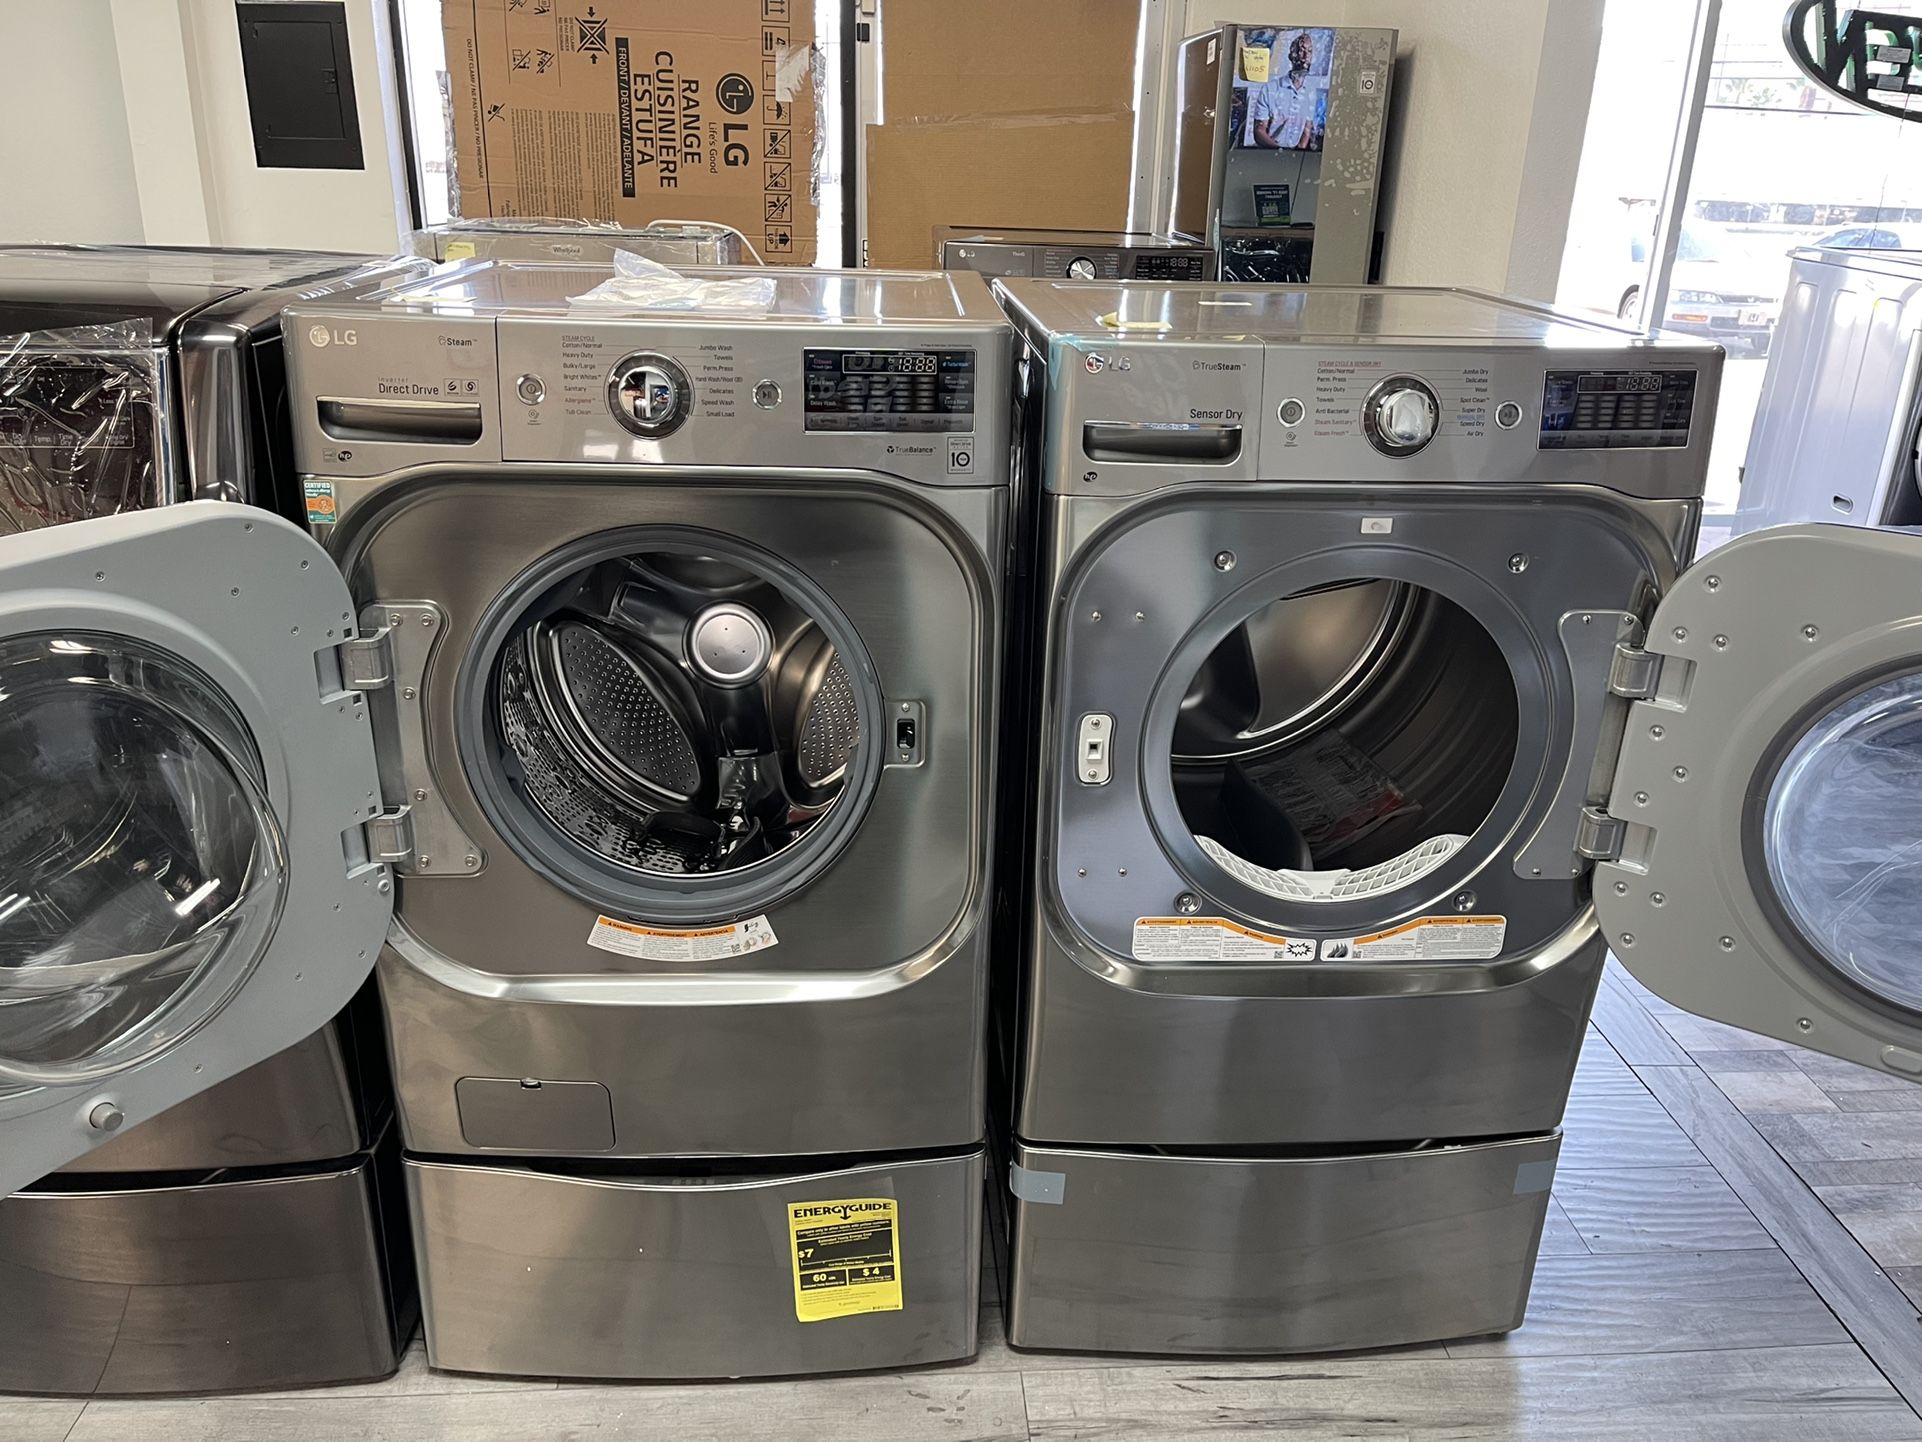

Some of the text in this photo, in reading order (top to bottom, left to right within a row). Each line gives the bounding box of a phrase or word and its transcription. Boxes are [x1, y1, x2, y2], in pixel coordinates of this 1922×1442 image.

[466, 38, 472, 48] DO
[619, 48, 628, 80] FRONT
[468, 62, 476, 83] CLAMP
[470, 88, 476, 96] NE
[620, 90, 630, 130] DEVANT
[634, 74, 654, 166] ESTUFA
[655, 51, 680, 188] CUISINIÈRE
[682, 79, 701, 164] RANGE
[475, 136, 481, 145] NO
[708, 122, 718, 174] Life's Good
[723, 123, 749, 166] LG
[476, 146, 484, 179] PRESIONAR
[623, 138, 633, 188] ADELANTE
[768, 233, 774, 244] UP
[334, 330, 357, 345] LG
[898, 357, 936, 371] 18:88
[1108, 356, 1130, 370] LG
[1201, 362, 1241, 371] TrueSteam
[378, 383, 439, 395] Direct Drive
[1190, 409, 1243, 421] Sensor Dry
[952, 452, 970, 467] 10
[794, 1203, 891, 1220] ENERGYGUIDE
[813, 1274, 826, 1282] 60
